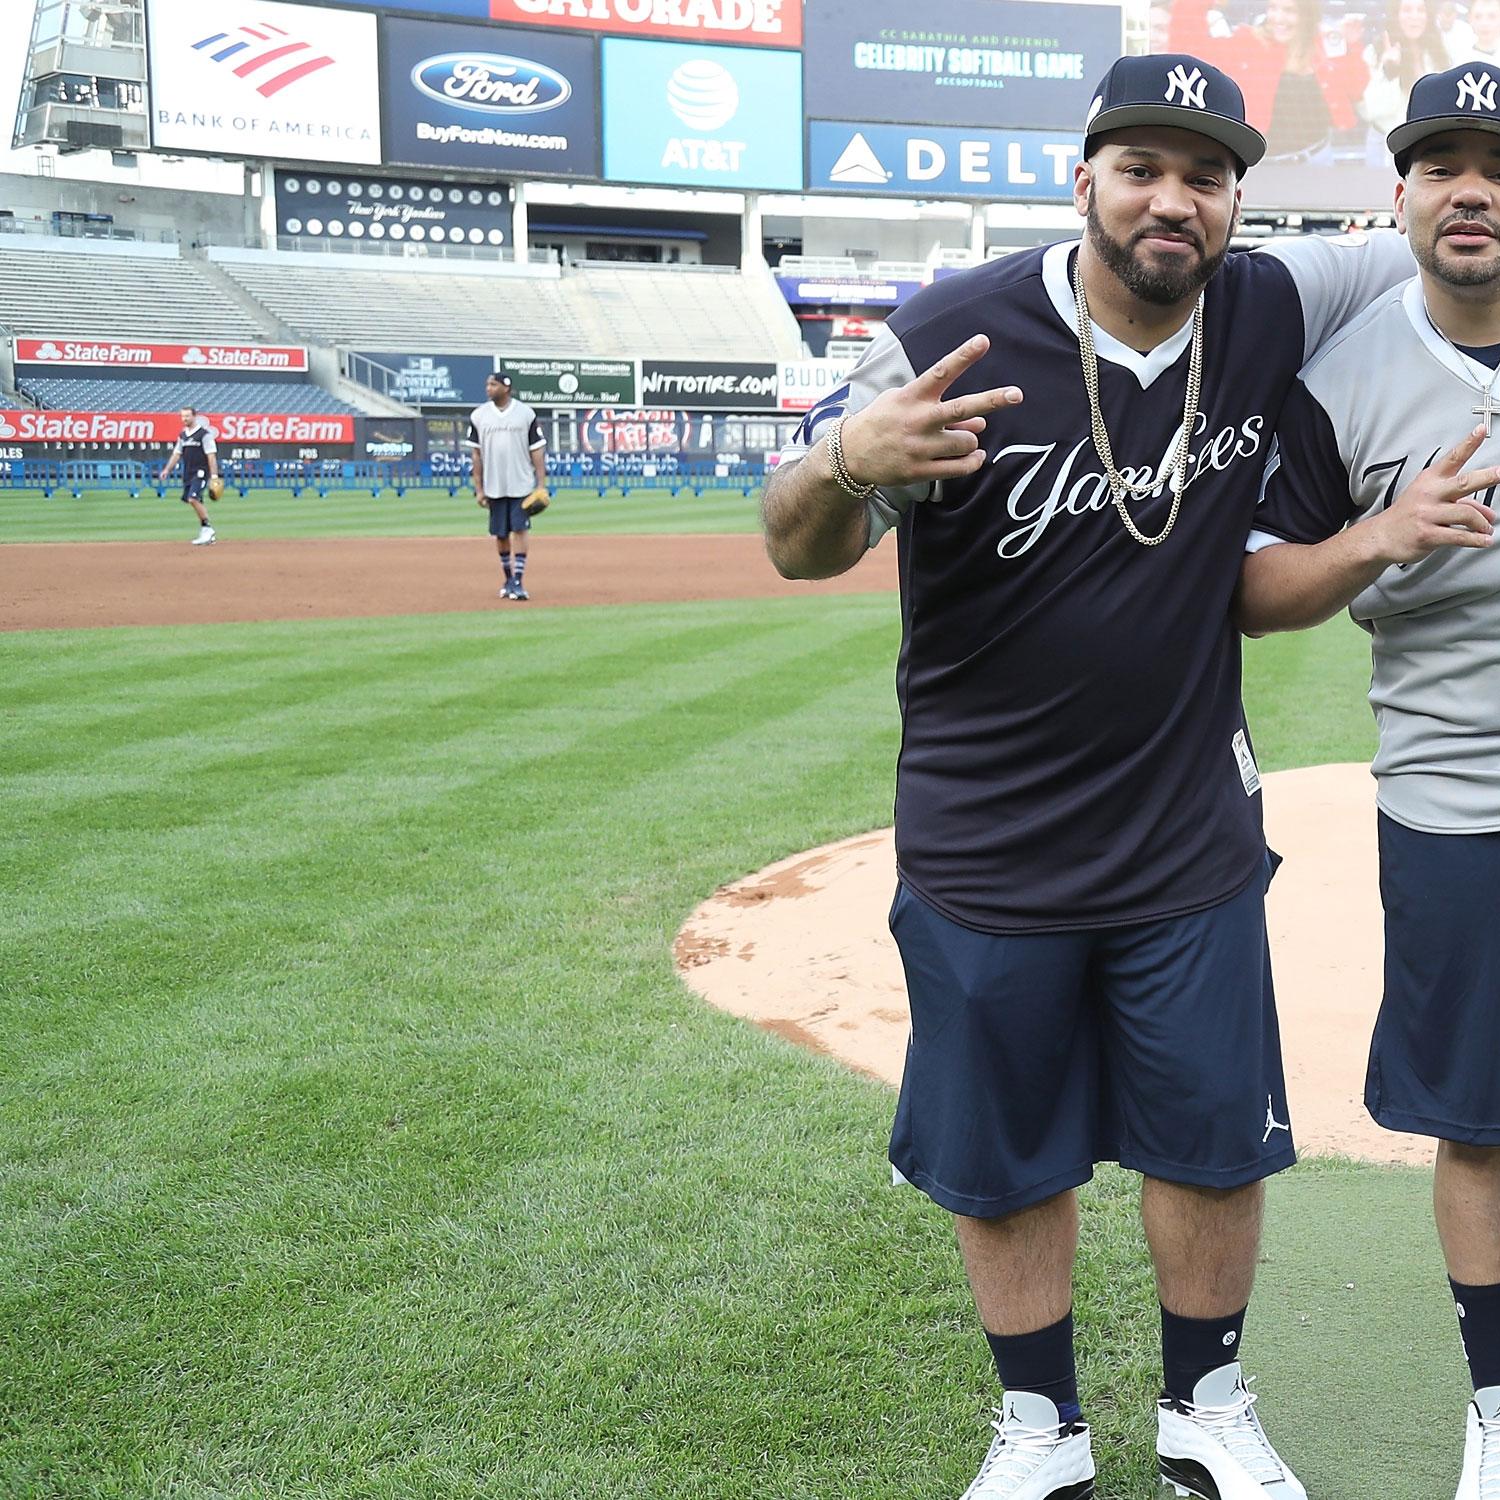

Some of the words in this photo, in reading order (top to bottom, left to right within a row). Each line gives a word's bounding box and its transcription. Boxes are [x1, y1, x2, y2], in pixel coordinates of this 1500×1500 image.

[901, 30, 966, 43] SABATHIA
[972, 35, 998, 45] AND
[1004, 36, 1060, 48] FRIENDS
[855, 42, 946, 72] CELEBRITY
[947, 48, 1032, 77] SOFTBALL
[1034, 52, 1084, 79] GAME
[444, 60, 540, 105] Ford
[1164, 64, 1208, 109] NY
[1456, 72, 1498, 111] NY
[159, 110, 222, 128] BANK
[232, 116, 260, 131] OF
[269, 120, 371, 140] AMERICA
[416, 122, 568, 151] BuyFordNow.com
[661, 138, 746, 172] AT&T
[906, 138, 1080, 185] DELT
[373, 202, 400, 222] York
[643, 371, 777, 396] NITTOTIRE.COM
[992, 411, 1264, 559] Yankees
